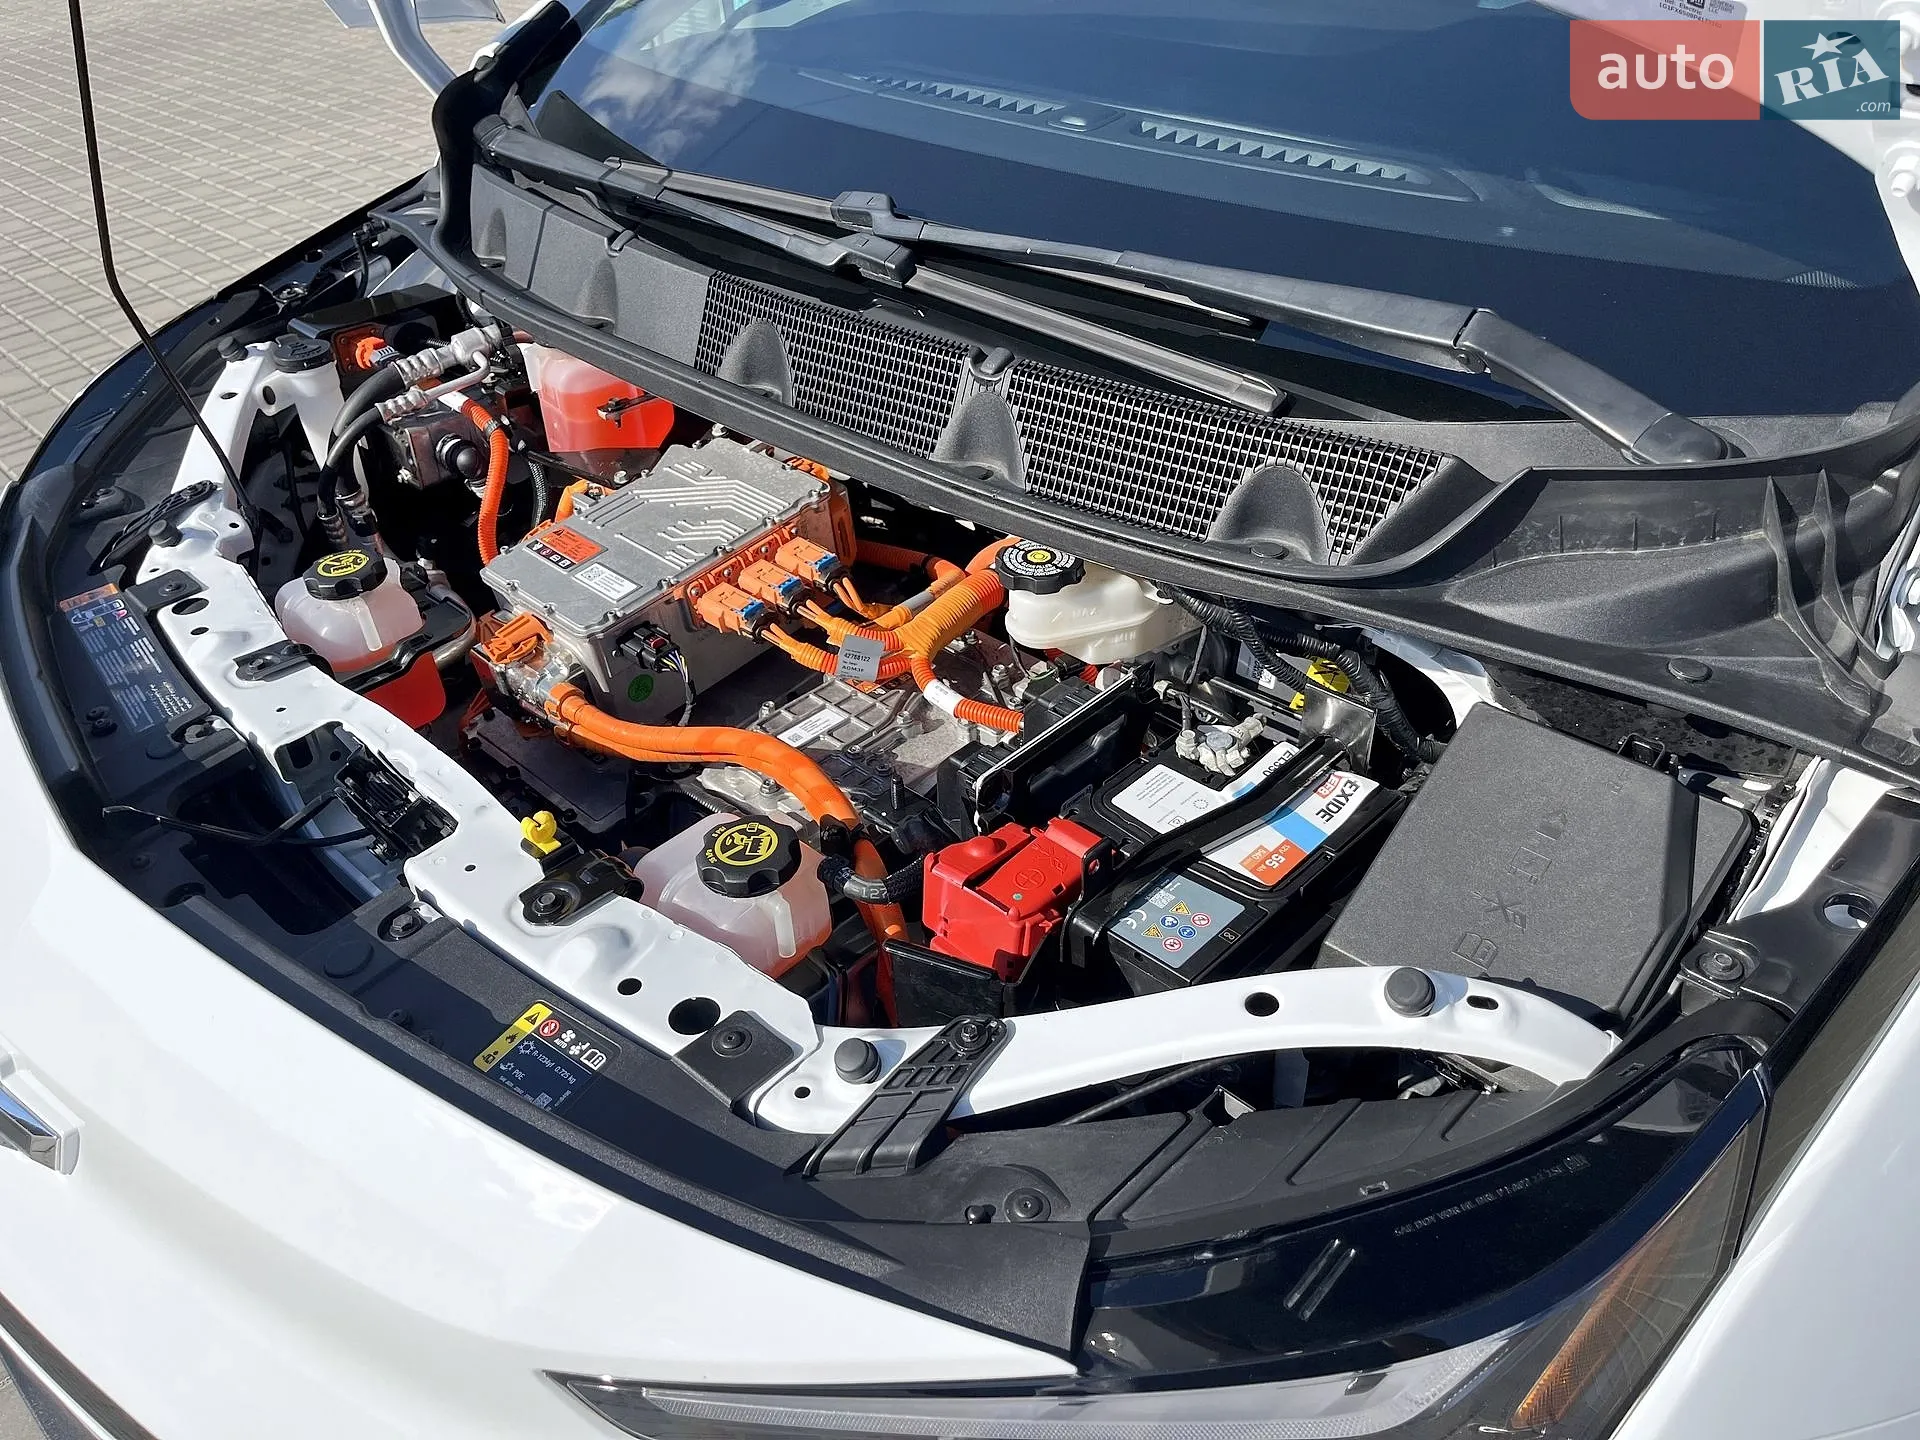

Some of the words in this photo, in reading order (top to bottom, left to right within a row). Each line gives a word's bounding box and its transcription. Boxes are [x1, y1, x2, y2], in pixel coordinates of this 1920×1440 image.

[1316, 778, 1361, 823] EXIDE
[1265, 853, 1286, 868] 55
[554, 1038, 568, 1048] AUTO
[512, 1069, 526, 1080] POE
[532, 1050, 555, 1068] R-1234yf
[554, 1066, 570, 1079] 0.725
[568, 1076, 576, 1084] kg
